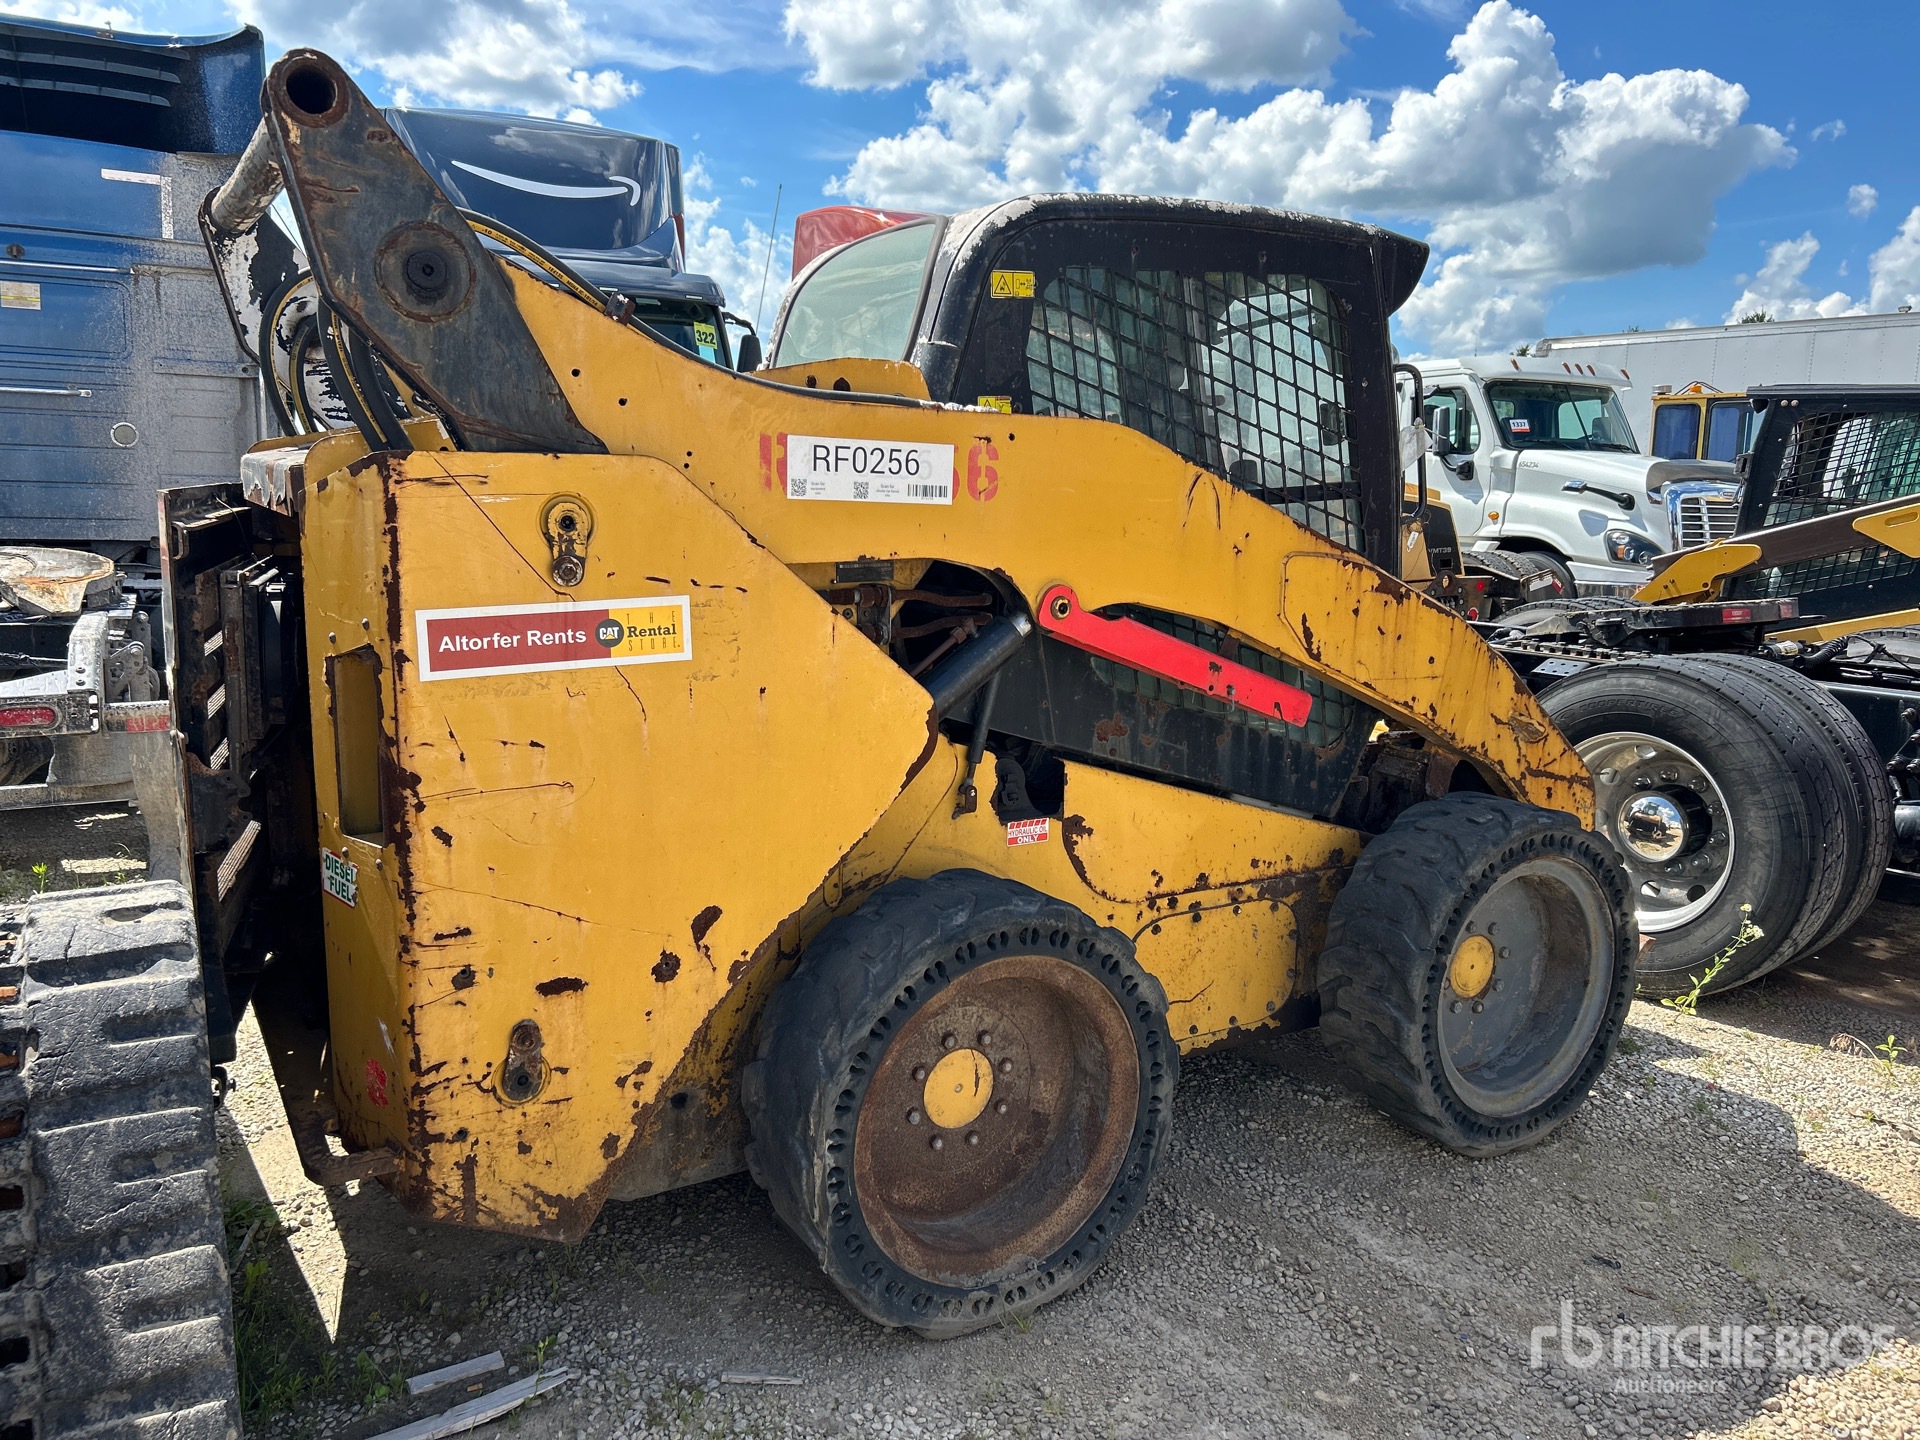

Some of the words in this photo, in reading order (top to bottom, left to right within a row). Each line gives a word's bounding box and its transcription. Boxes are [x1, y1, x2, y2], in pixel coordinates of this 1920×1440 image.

[696, 329, 715, 345] 322
[813, 444, 920, 476] RF0256
[599, 626, 620, 640] CAT
[626, 623, 677, 638] Rental
[438, 632, 521, 653] Altorfer
[526, 628, 587, 647] Rents
[1009, 826, 1038, 837] HYDRAULIC
[1039, 825, 1047, 833] OIL
[1017, 834, 1039, 844] ONLY
[329, 874, 352, 903] FUEL
